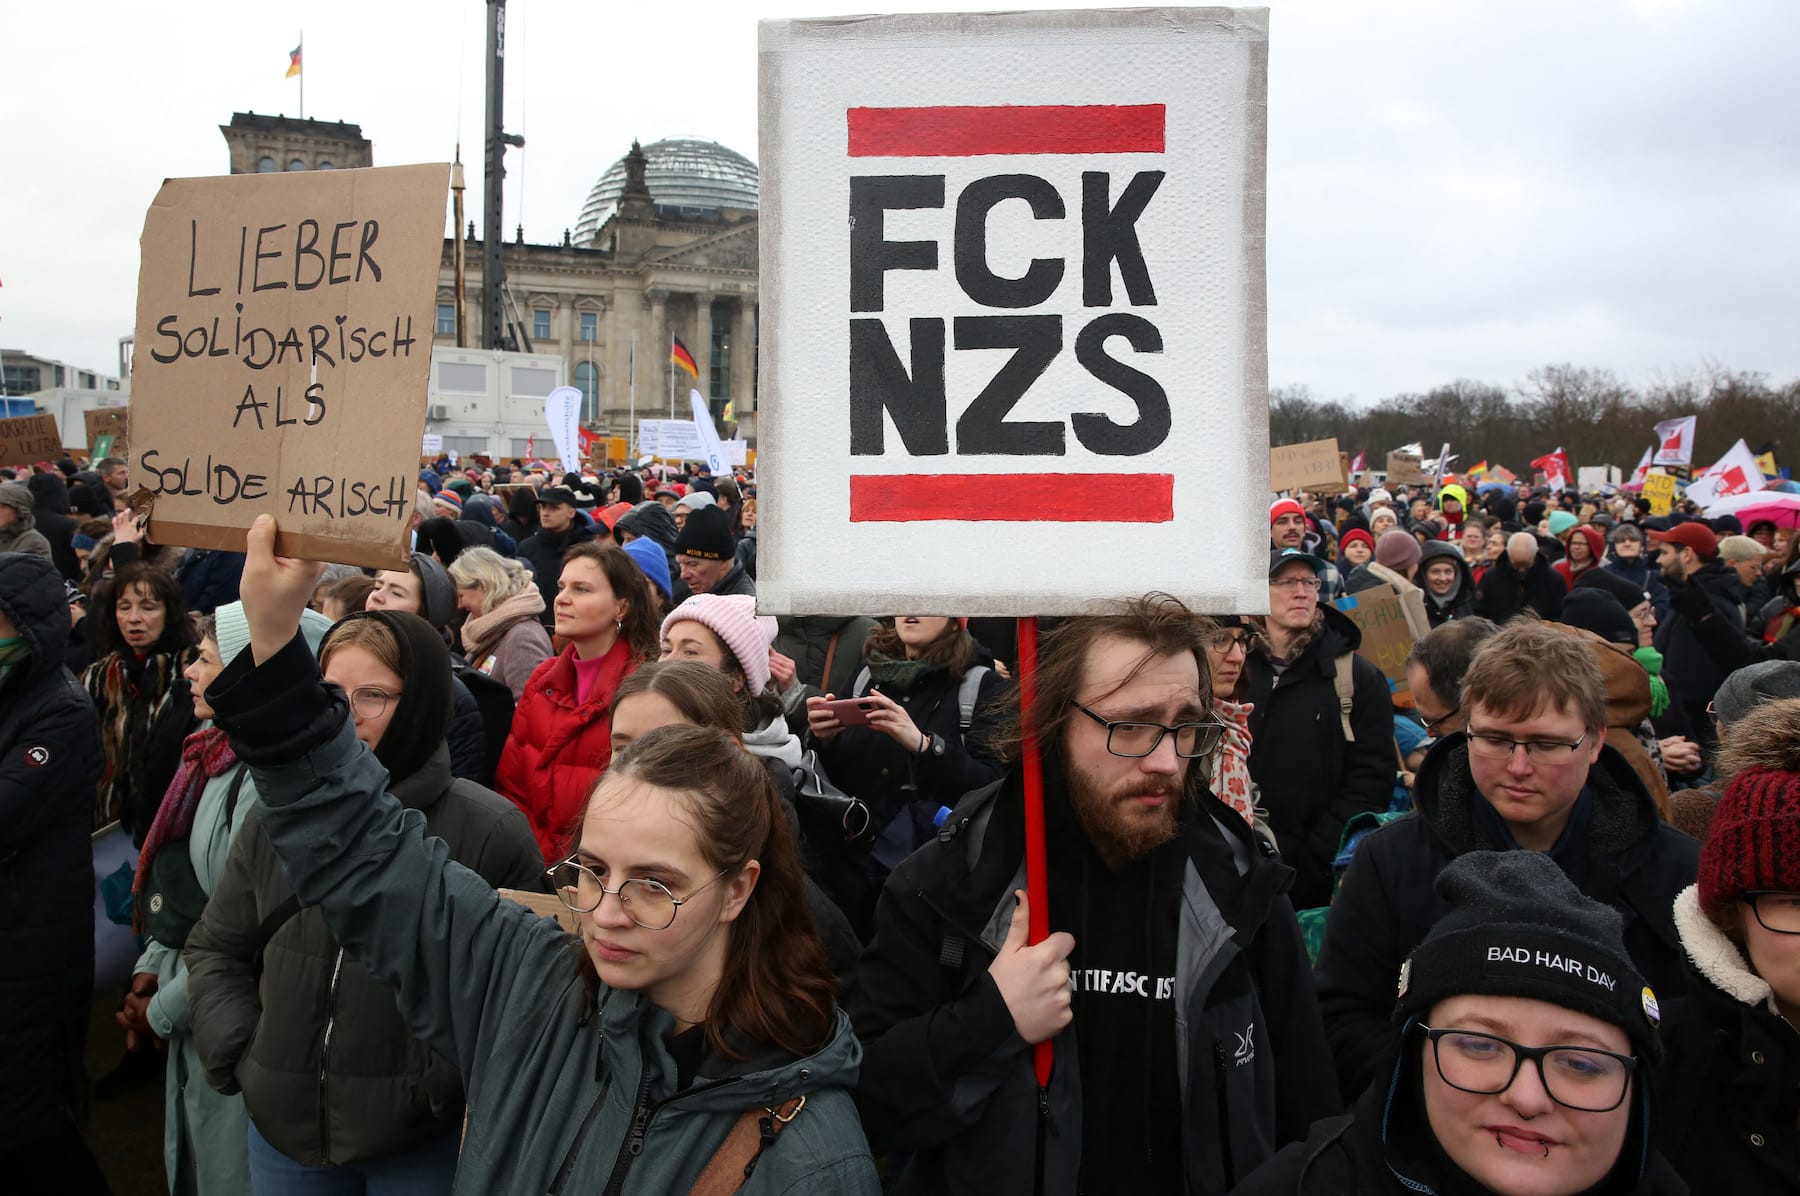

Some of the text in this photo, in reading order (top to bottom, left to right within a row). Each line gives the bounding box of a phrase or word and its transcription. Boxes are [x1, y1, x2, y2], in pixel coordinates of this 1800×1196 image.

[188, 219, 382, 298] LIEBER
[850, 170, 1166, 313] FCK
[233, 383, 326, 430] ALS
[849, 312, 1172, 457] NZS
[138, 449, 408, 521] SOLIDE ARISCH
[1487, 946, 1617, 992] BAD HAIR DAY
